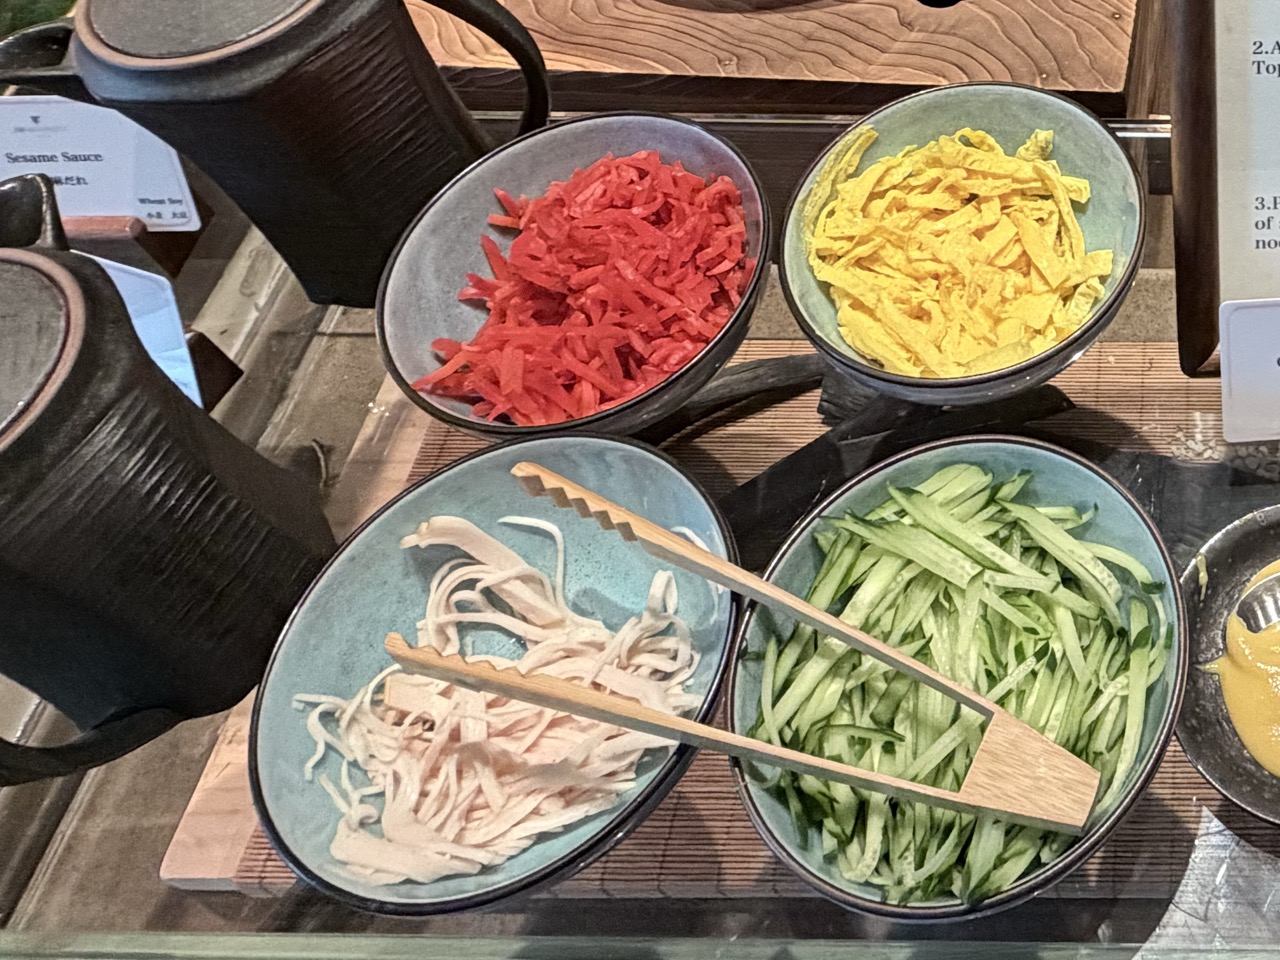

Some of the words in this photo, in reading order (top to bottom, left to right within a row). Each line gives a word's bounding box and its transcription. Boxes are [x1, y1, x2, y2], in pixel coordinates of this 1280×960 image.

[5, 152, 59, 164] Sesame
[61, 151, 104, 163] Sauce
[51, 176, 89, 187] 麻だれ
[1254, 216, 1275, 230] of
